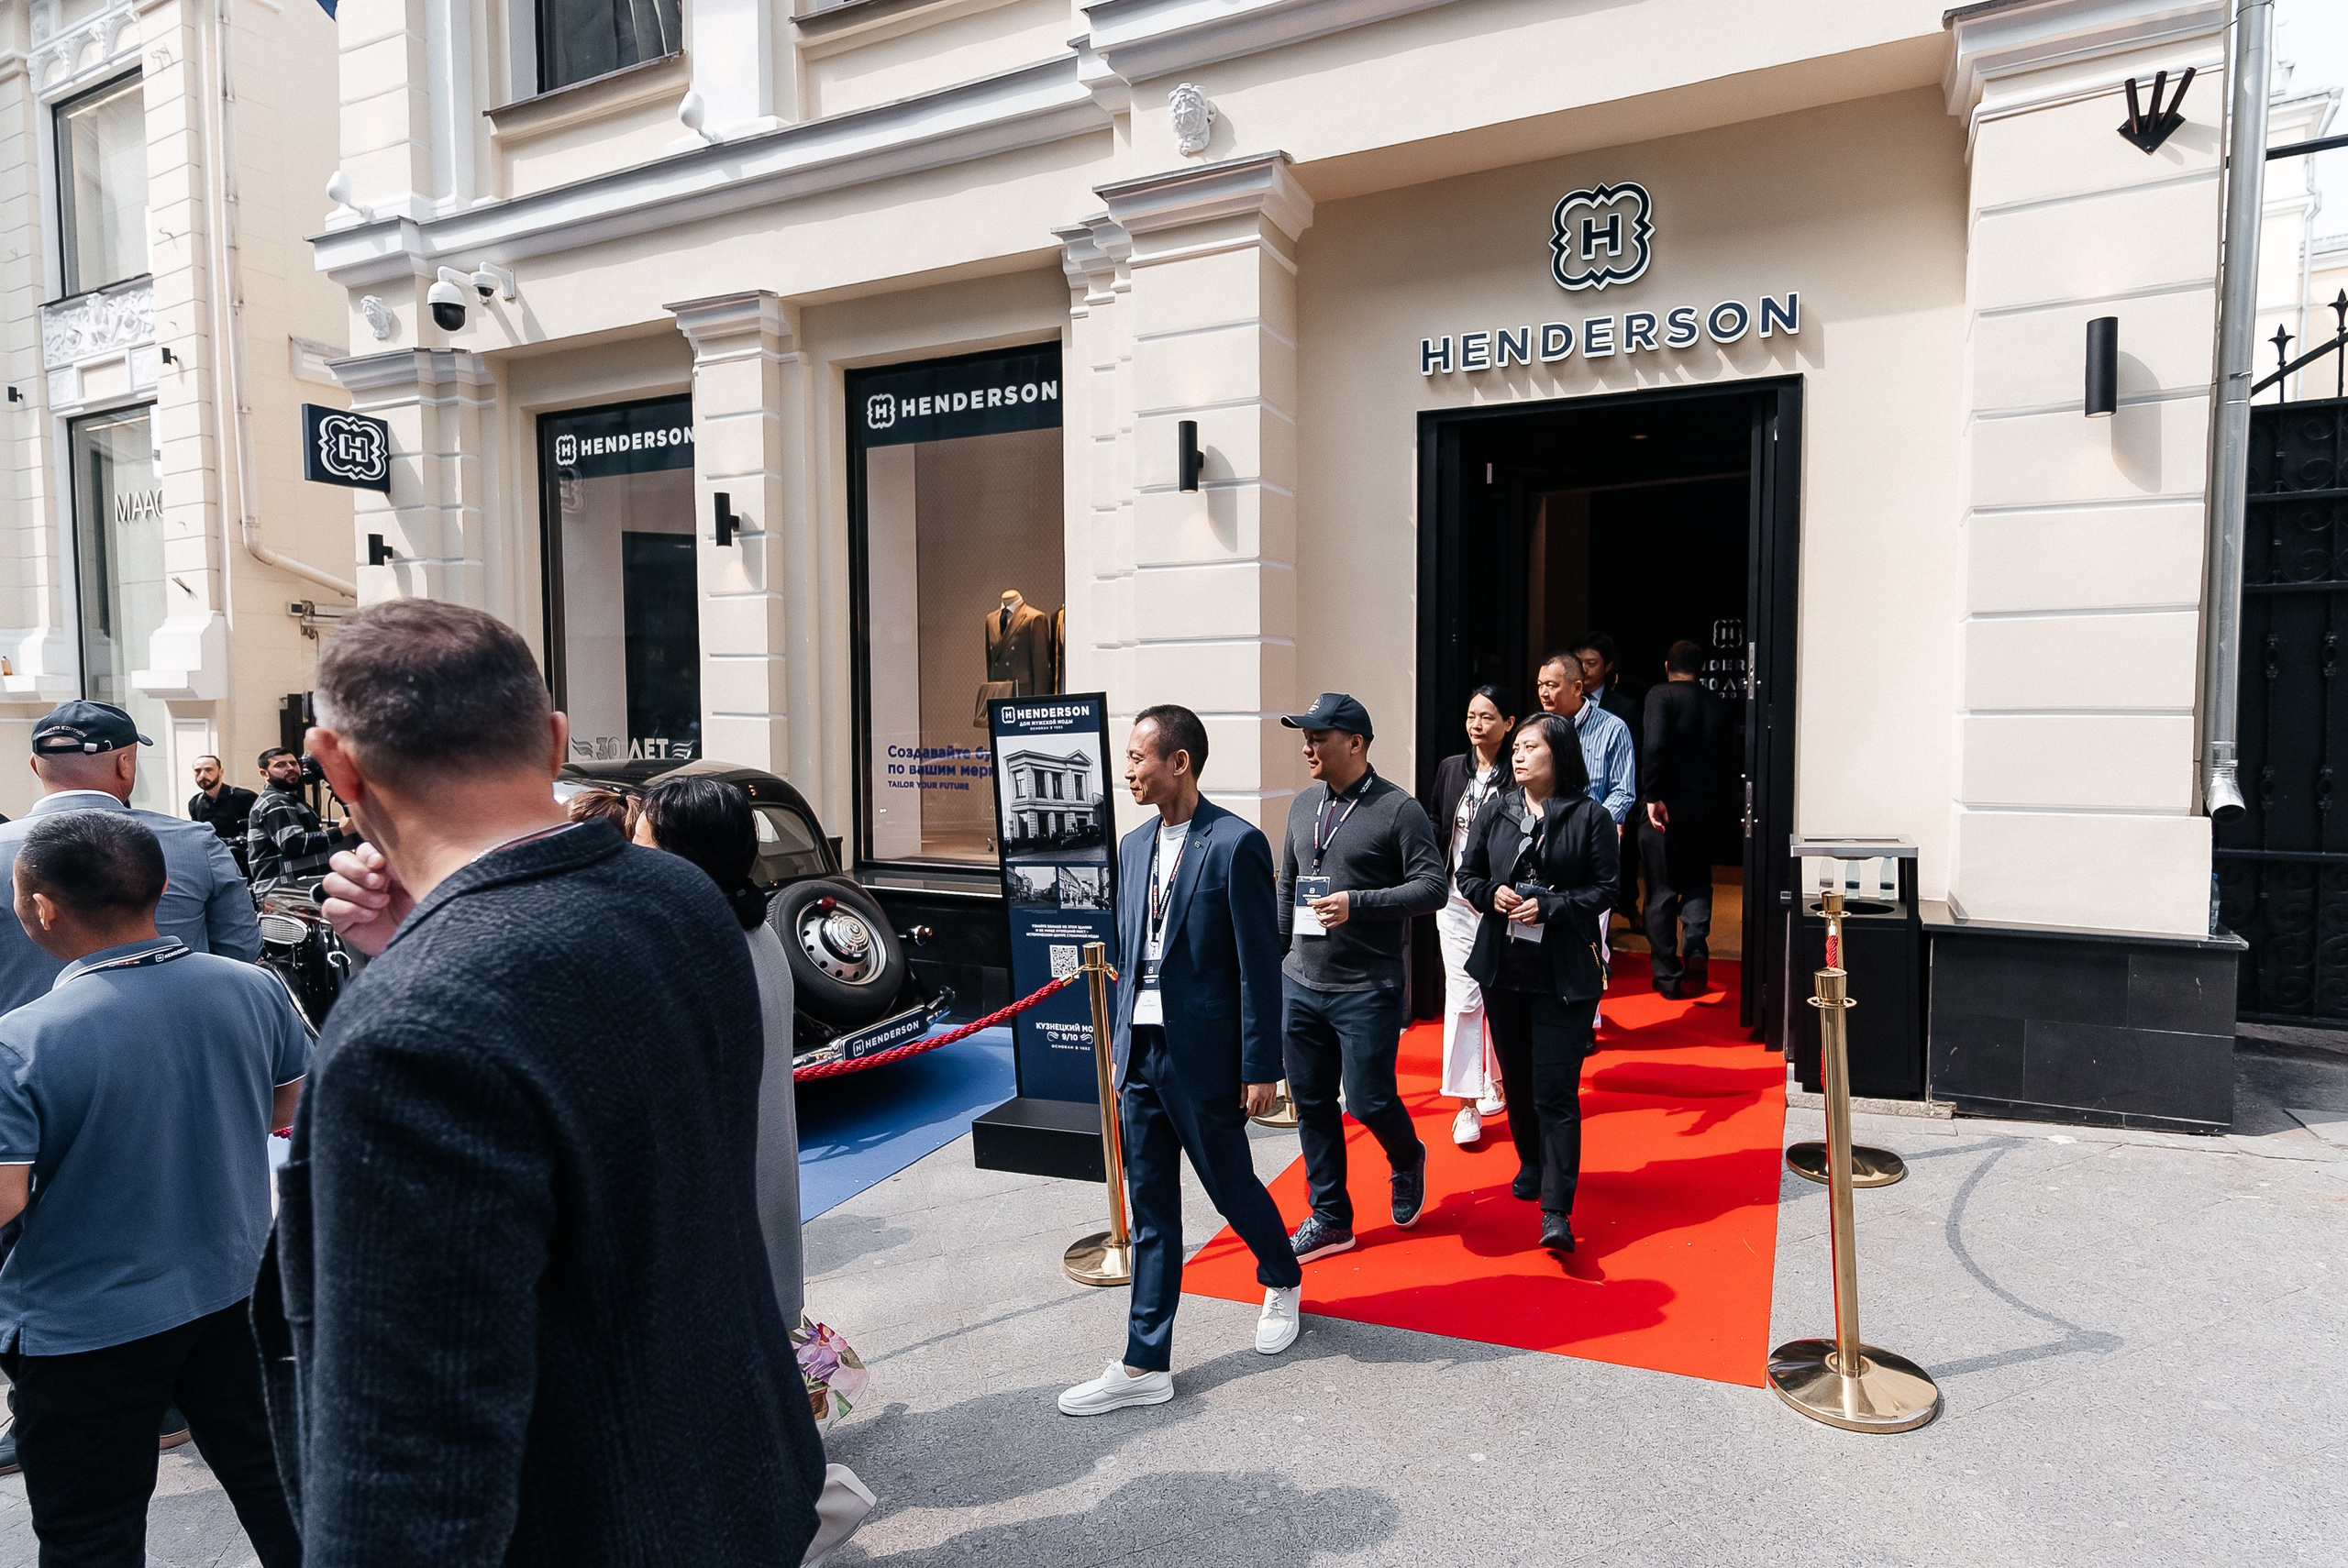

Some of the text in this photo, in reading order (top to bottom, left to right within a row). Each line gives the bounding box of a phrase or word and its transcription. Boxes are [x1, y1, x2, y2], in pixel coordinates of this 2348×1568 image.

[1421, 291, 1800, 376] HENDERSON
[902, 381, 1058, 417] HENDERSON
[581, 425, 695, 456] HENDERSON
[1017, 706, 1090, 719] HENDERSON
[628, 737, 669, 759] ЛЕТ
[888, 745, 970, 760] Создавайте
[888, 764, 904, 775] по
[909, 765, 956, 776] вашим
[888, 780, 969, 790] TAILOR YOUR FUTURE
[1036, 1021, 1080, 1032] КУЗНЕЦКИЙ
[865, 1021, 919, 1049] HENDERSON
[1061, 1032, 1078, 1042] 9/10
